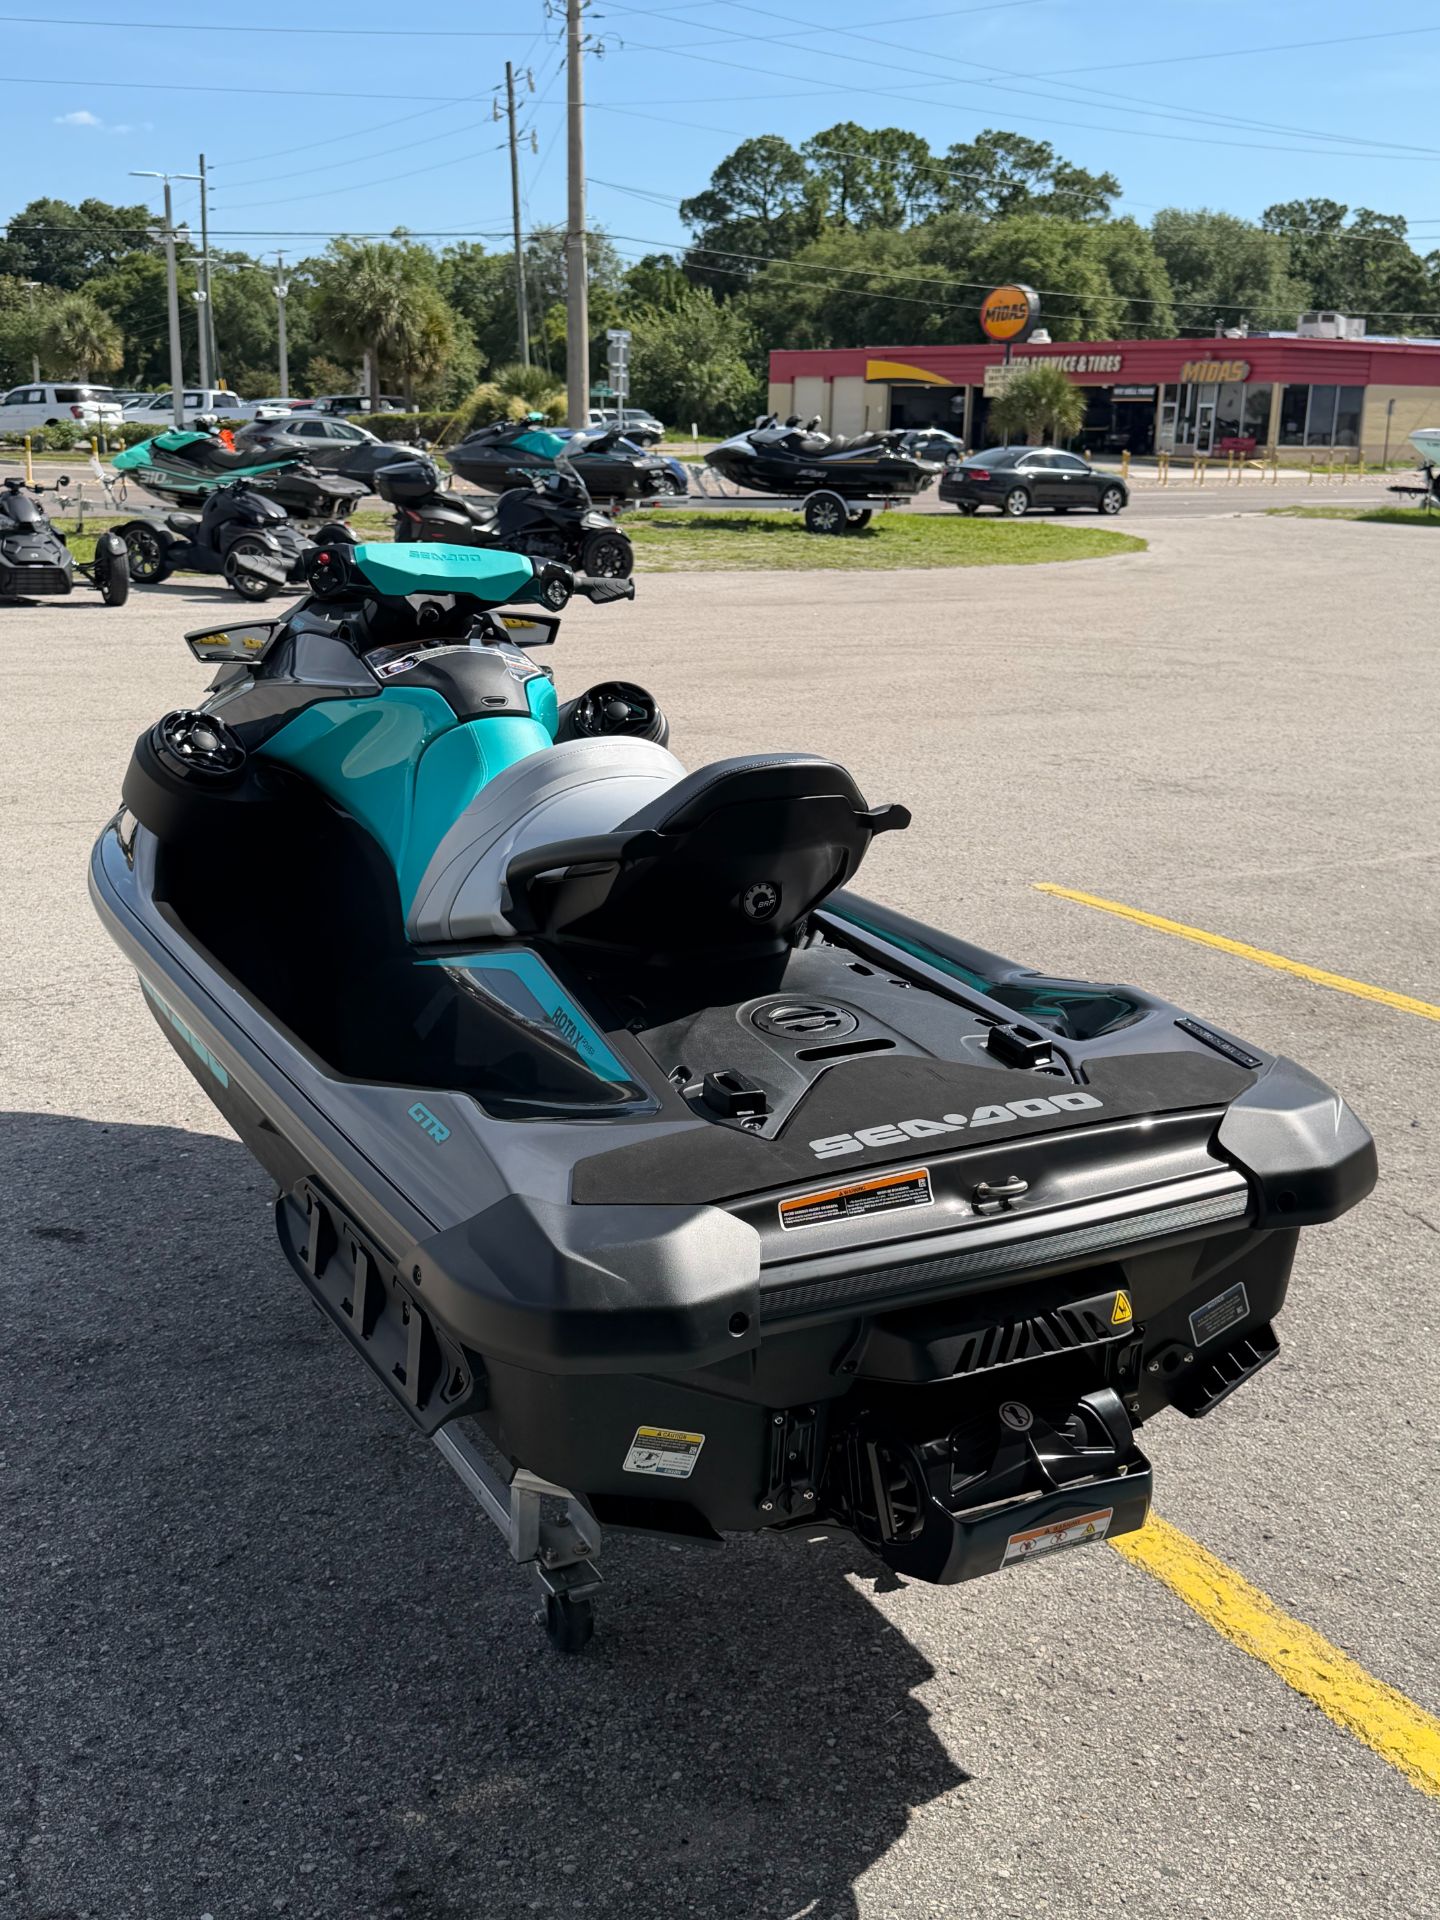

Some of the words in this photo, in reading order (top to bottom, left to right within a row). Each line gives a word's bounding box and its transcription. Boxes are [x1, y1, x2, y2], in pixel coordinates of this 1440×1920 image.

[985, 303, 1026, 323] MIDAS
[1077, 355, 1087, 372] &
[1088, 355, 1122, 372] TIRES
[1182, 360, 1245, 382] MIDAS
[758, 899, 775, 909] BRP
[552, 1006, 584, 1049] ROTAX
[407, 1102, 451, 1145] GTR
[662, 1431, 687, 1440] CAUTION
